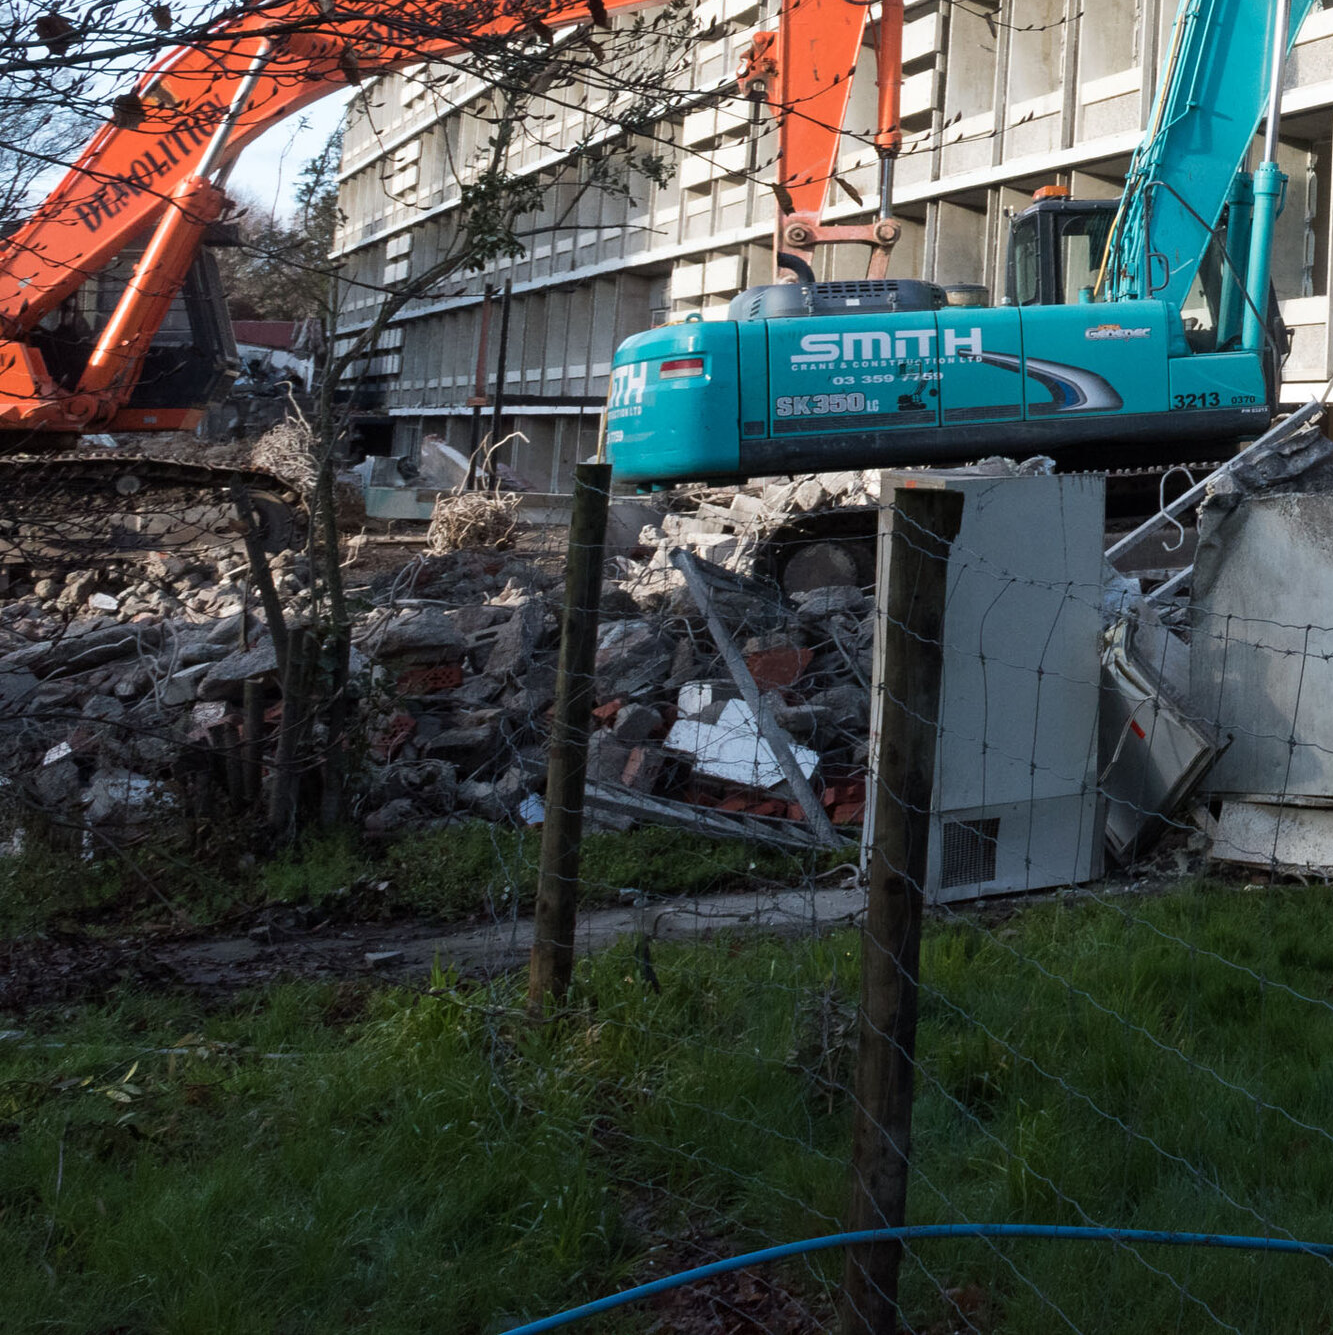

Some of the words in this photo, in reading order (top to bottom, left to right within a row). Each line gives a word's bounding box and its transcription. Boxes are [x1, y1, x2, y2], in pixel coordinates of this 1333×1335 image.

[791, 361, 835, 372] CRANE
[840, 361, 848, 370] &
[852, 356, 955, 369] CONSTRUCTION
[959, 355, 983, 364] LTD
[832, 376, 855, 386] 03
[861, 373, 895, 384] 359
[901, 371, 945, 382] 7759
[776, 391, 866, 417] SK350
[866, 399, 880, 413] LC
[1173, 392, 1221, 410] 3213
[1231, 395, 1256, 405] 0370
